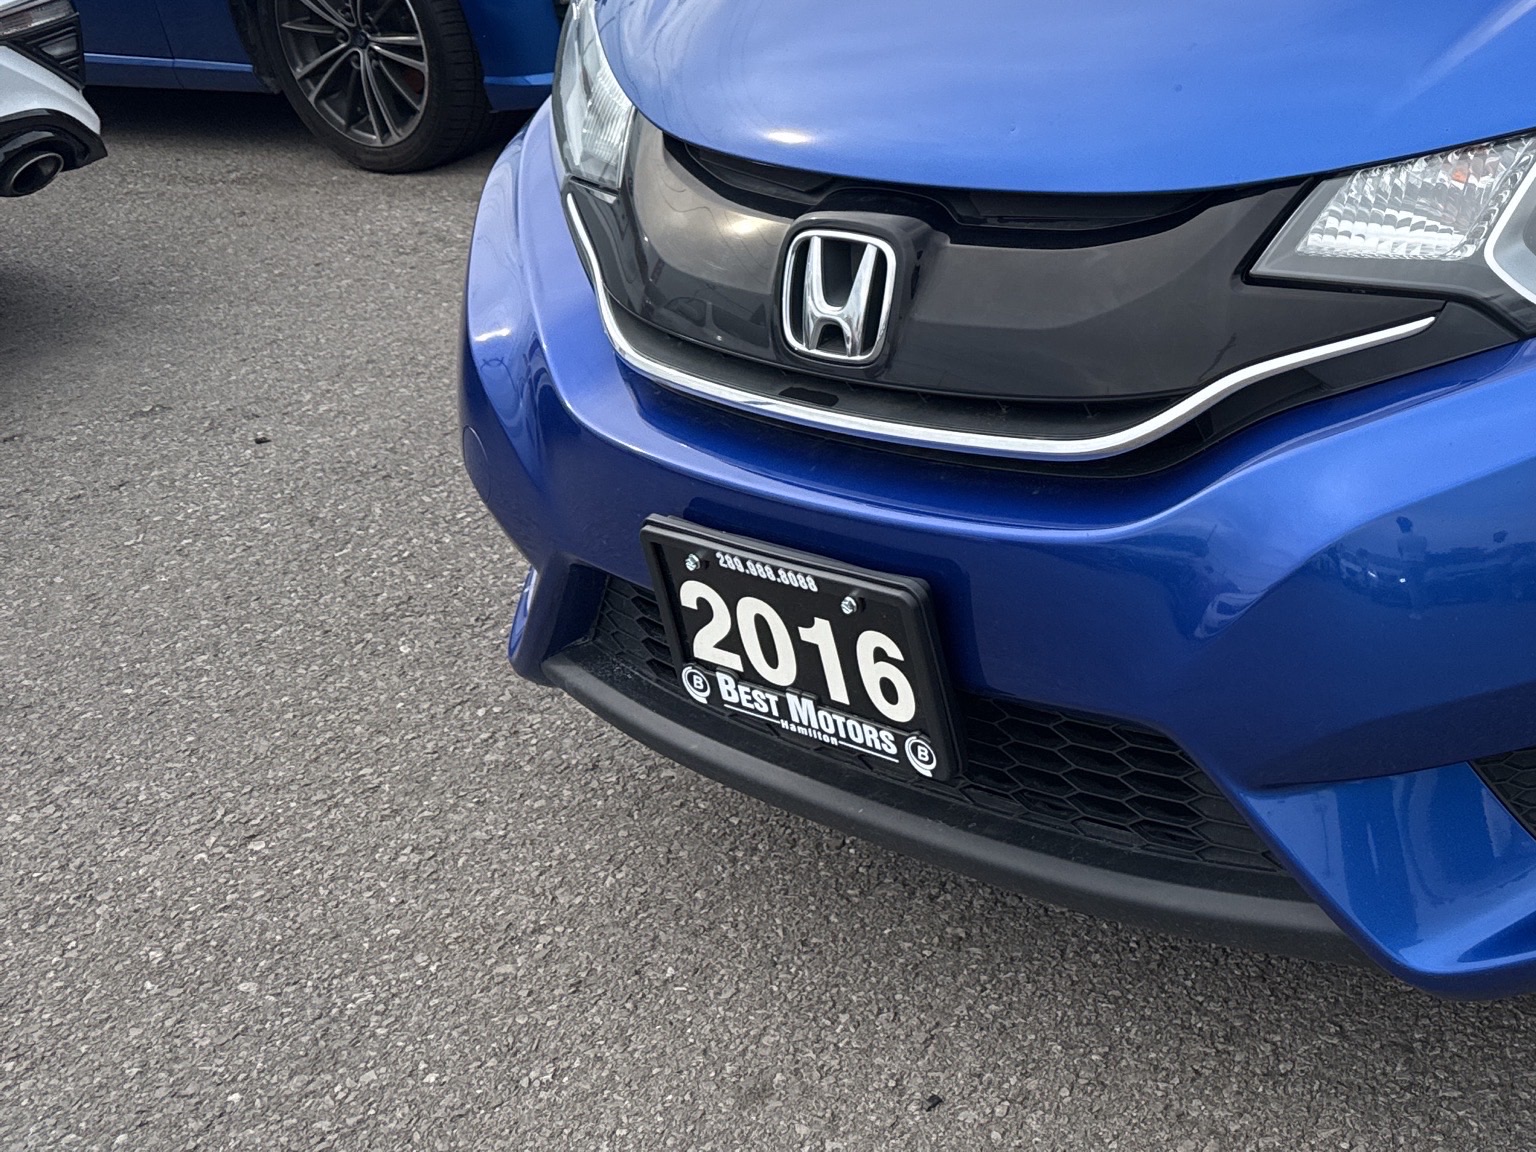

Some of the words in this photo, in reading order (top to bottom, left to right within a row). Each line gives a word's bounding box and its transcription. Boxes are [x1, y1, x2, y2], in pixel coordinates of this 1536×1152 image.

[715, 552, 818, 592] 289.988.8088
[679, 579, 916, 724] 2016
[715, 670, 779, 717] BEST
[785, 690, 899, 756] MOTORS
[780, 719, 839, 747] Hamilton
